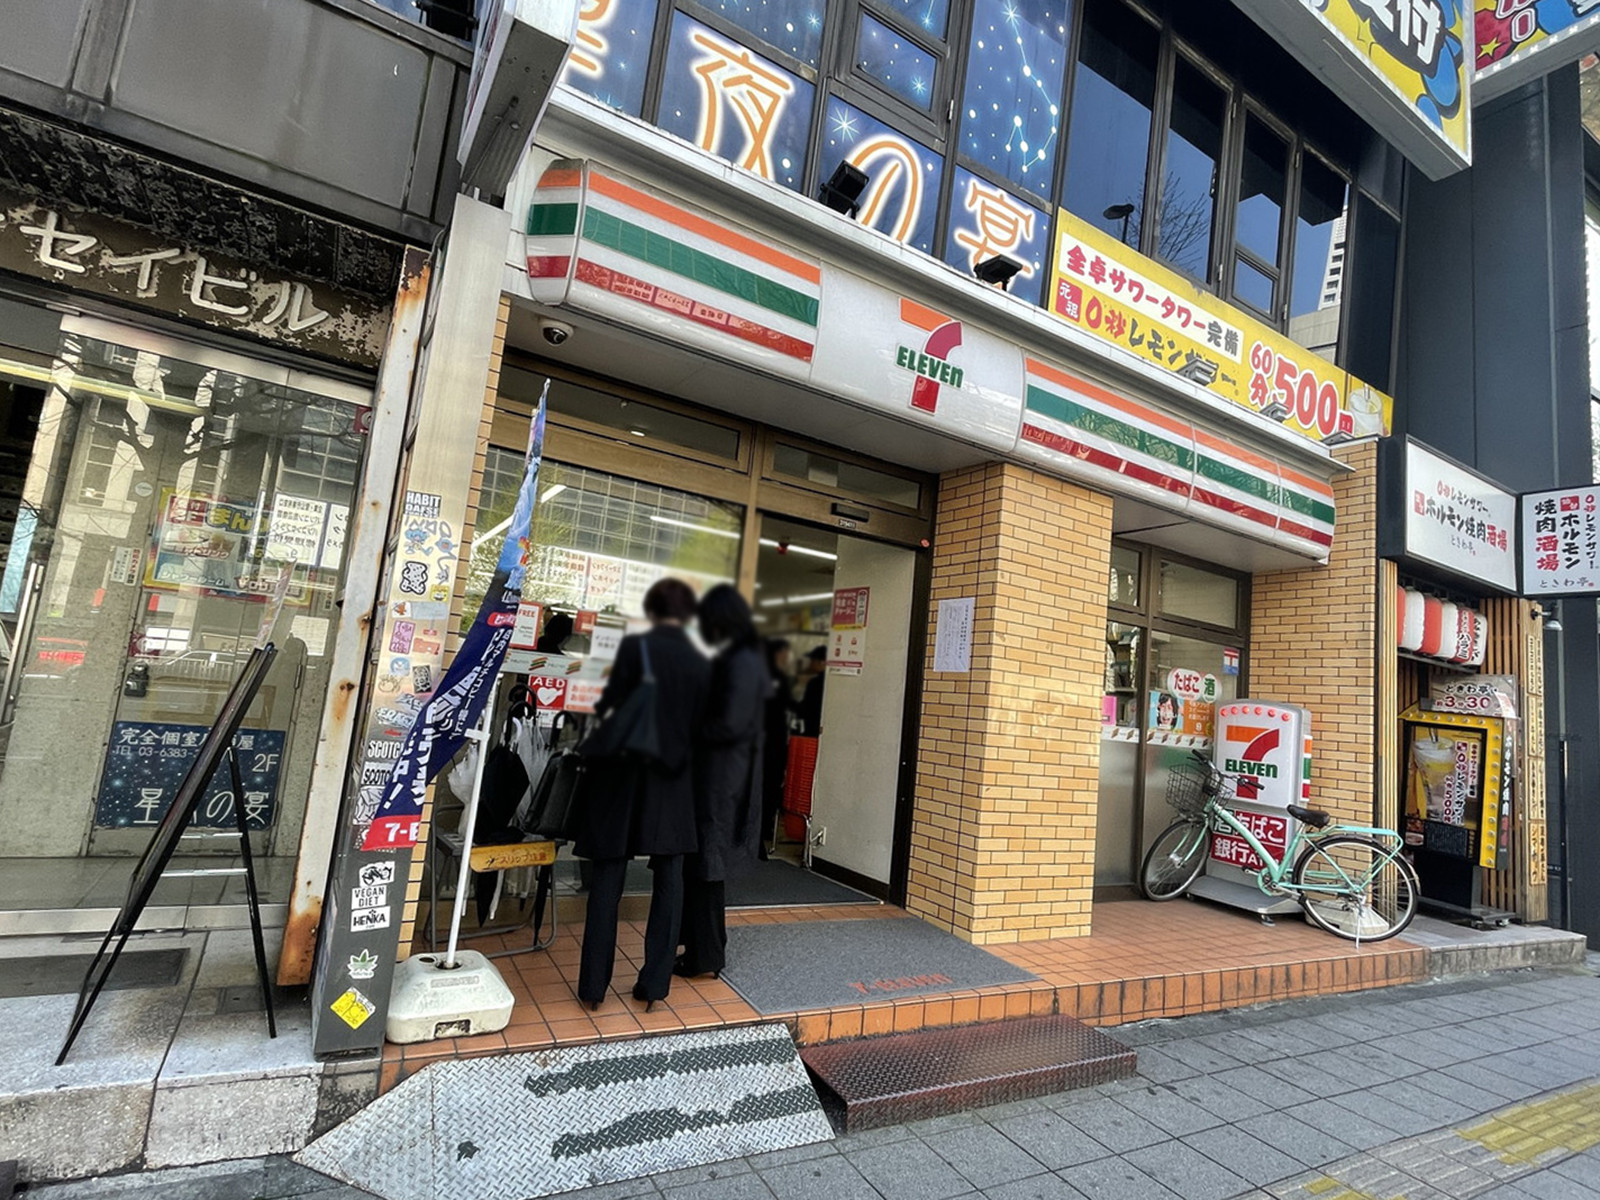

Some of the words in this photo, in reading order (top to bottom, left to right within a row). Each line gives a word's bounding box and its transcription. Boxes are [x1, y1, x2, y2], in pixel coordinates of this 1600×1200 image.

[1066, 245, 1239, 357] 全卓サワータワー完備
[406, 491, 441, 508] HABIT
[1534, 498, 1560, 572] 焼肉酒場
[1560, 513, 1581, 570] ホルモン
[532, 676, 566, 689] AED
[1174, 672, 1200, 693] たばこ
[1203, 677, 1216, 697] 酒
[251, 753, 280, 773] 2F
[133, 787, 270, 825] 星の宴
[354, 886, 385, 899] VEGAN
[358, 896, 380, 908] DIET
[352, 912, 386, 927] HENKA
